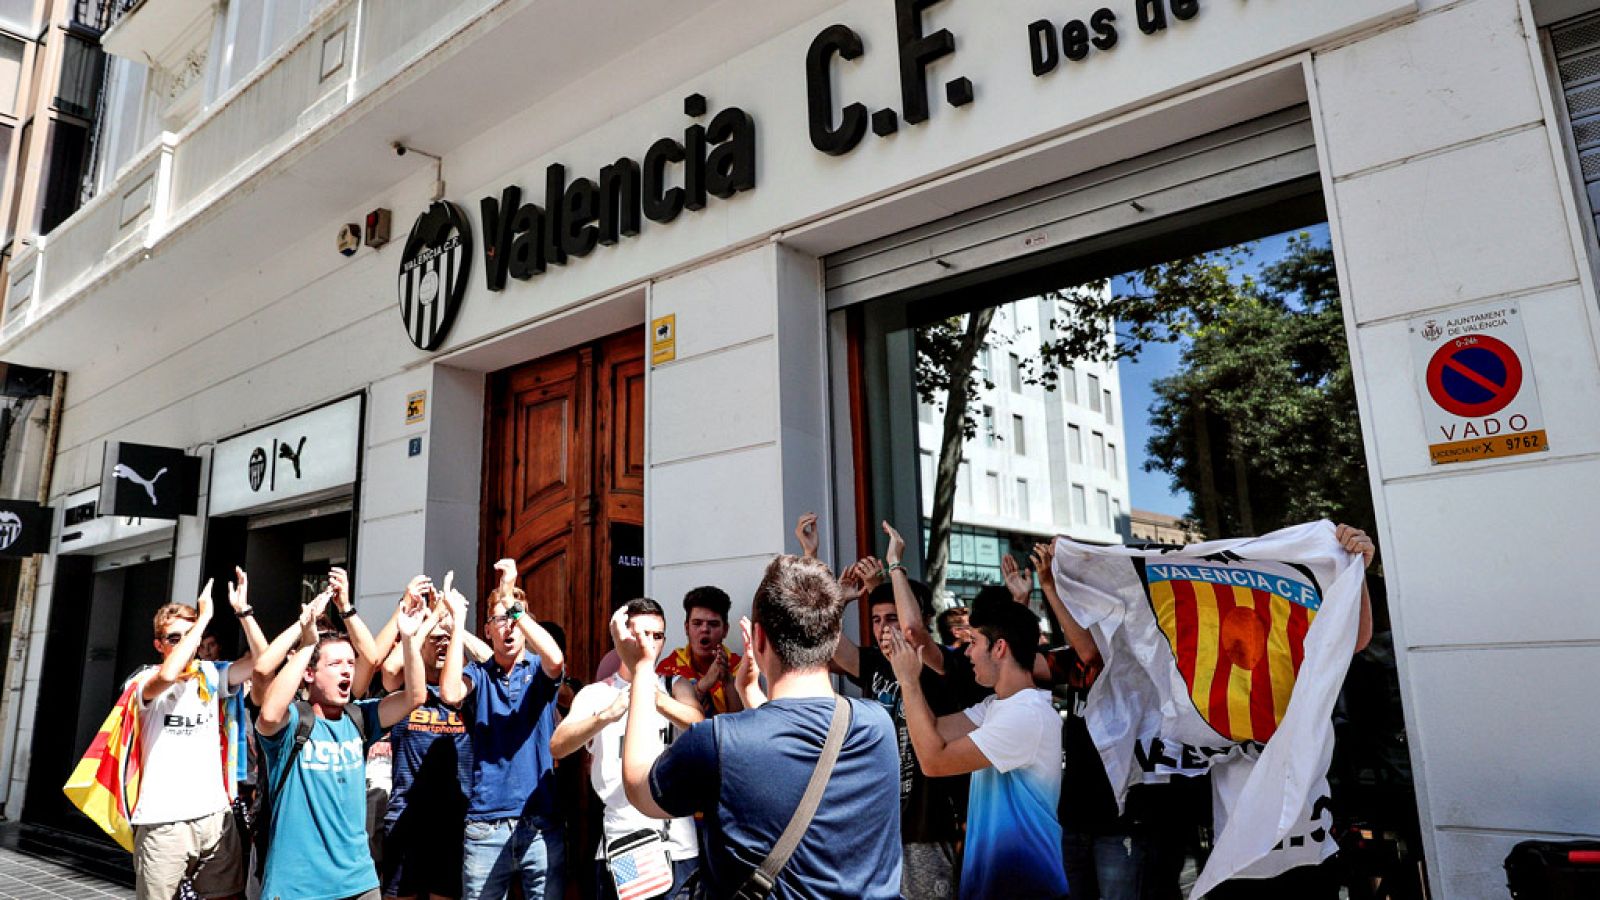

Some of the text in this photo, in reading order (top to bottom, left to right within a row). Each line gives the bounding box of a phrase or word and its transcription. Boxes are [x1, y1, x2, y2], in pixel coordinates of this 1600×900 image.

[1028, 8, 1117, 77] Des
[480, 0, 973, 292] Valencia C.F.
[404, 245, 443, 271] VALENCIA
[1446, 309, 1506, 327] AJUNTAMENT
[1448, 327, 1460, 336] DE
[1440, 414, 1528, 441] VADO
[1432, 446, 1470, 458] LICENCIA
[1505, 435, 1539, 451] 9762
[1152, 566, 1320, 609] VALENCIA C.F.
